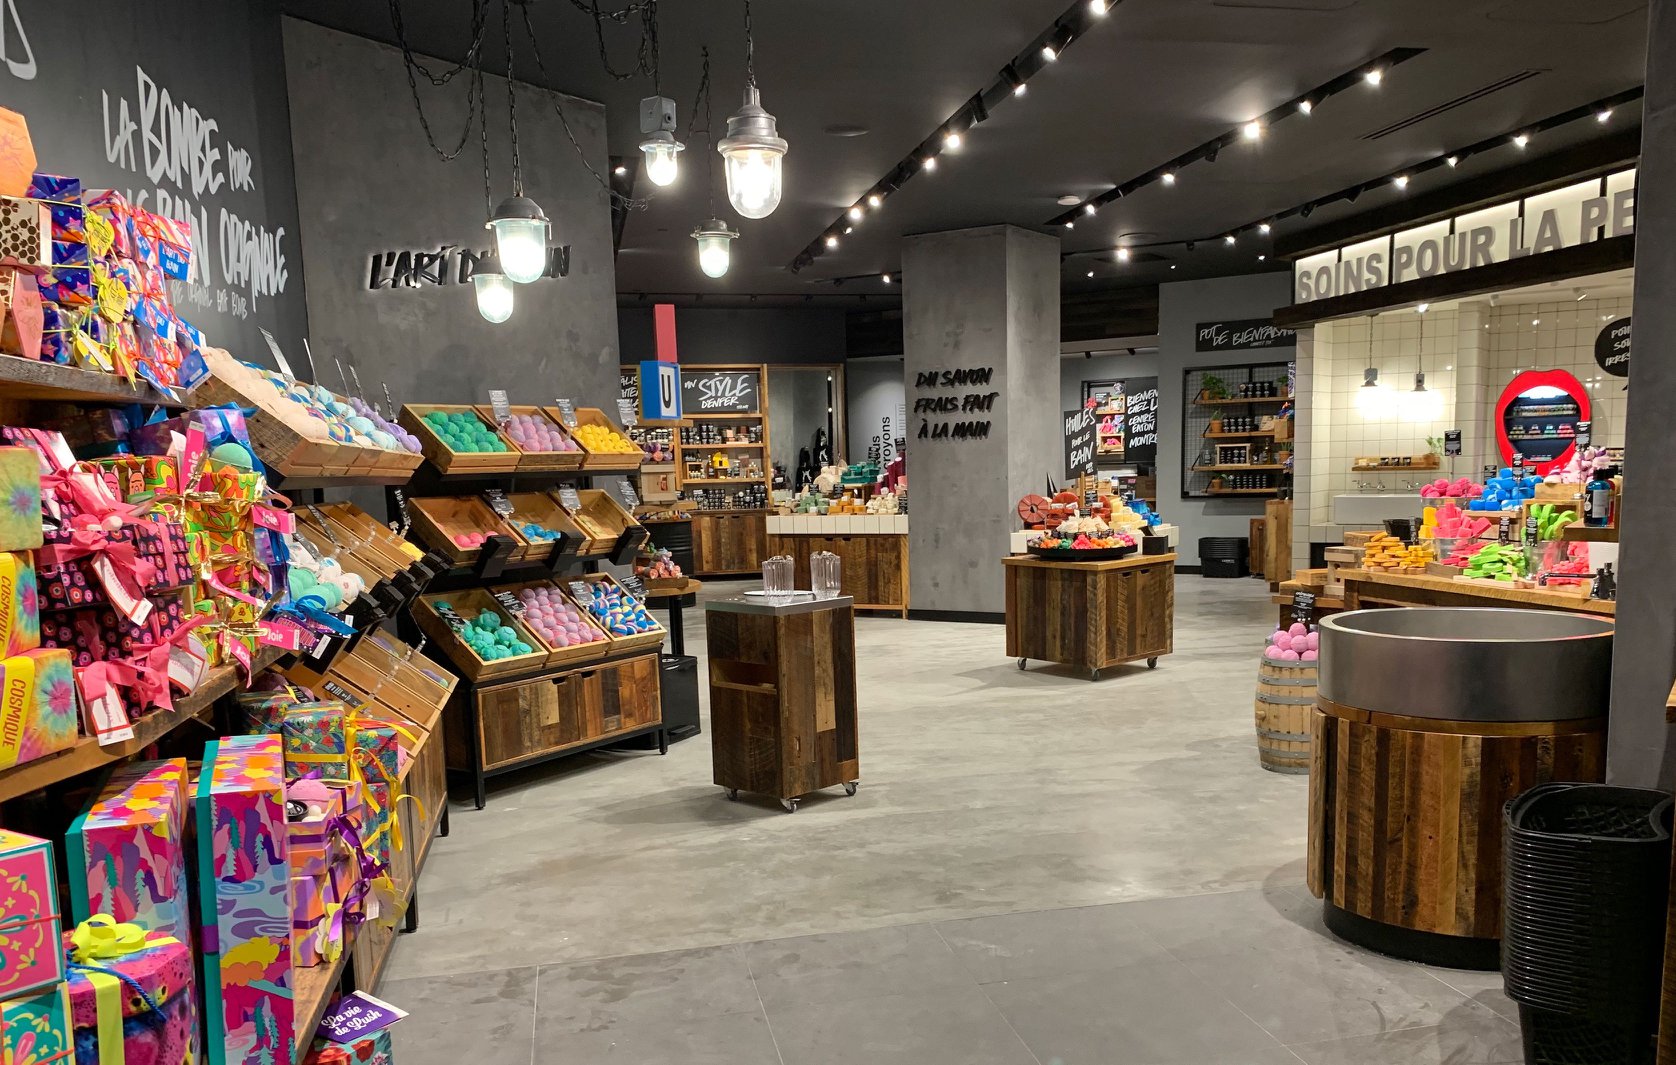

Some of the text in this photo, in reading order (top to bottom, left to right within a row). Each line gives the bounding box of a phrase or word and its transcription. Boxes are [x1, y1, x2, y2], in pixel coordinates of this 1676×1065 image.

[102, 89, 138, 172] LA
[136, 64, 225, 200] BOMBE
[369, 244, 458, 290] L'ART
[1298, 252, 1385, 302] SOINS
[1391, 225, 1496, 283] POUR
[1508, 207, 1564, 260] LA
[661, 373, 672, 409] U
[697, 374, 752, 401] STYLE
[915, 367, 994, 389] DU SAVON
[913, 392, 1000, 415] FRAIS FAIT
[917, 418, 929, 440] À
[931, 422, 949, 440] LA
[950, 420, 992, 441] MAIN
[1128, 411, 1155, 426] CENTRE
[1132, 420, 1155, 434] EATON
[1070, 441, 1095, 470] BAIN
[267, 629, 284, 643] Joie
[3, 678, 26, 750] COSMIQUE
[321, 1005, 362, 1029] La vie
[334, 1009, 383, 1036] de Lush
